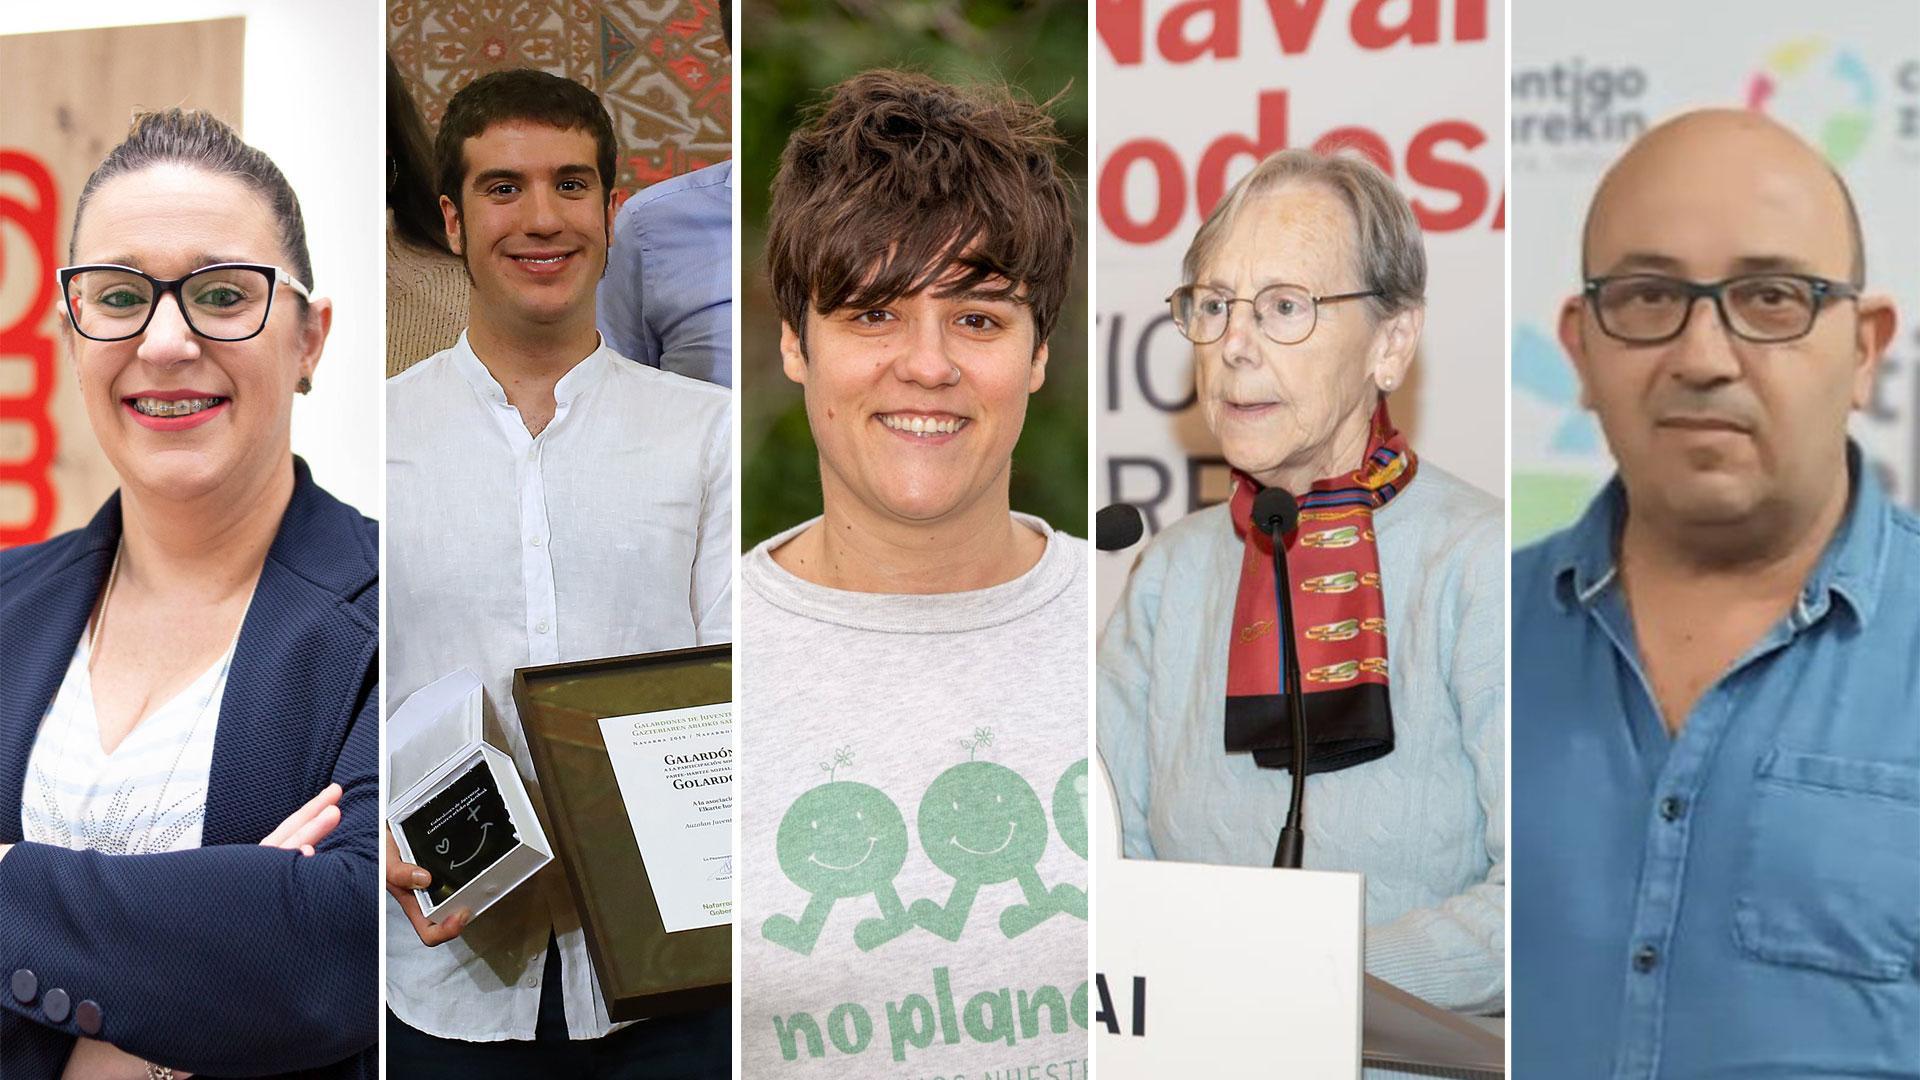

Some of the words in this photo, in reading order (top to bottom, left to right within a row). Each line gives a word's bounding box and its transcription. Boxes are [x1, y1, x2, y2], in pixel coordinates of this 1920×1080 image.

[1511, 98, 1646, 144] rekin
[1097, 89, 1505, 245] ods
[772, 1002, 874, 1062] no
